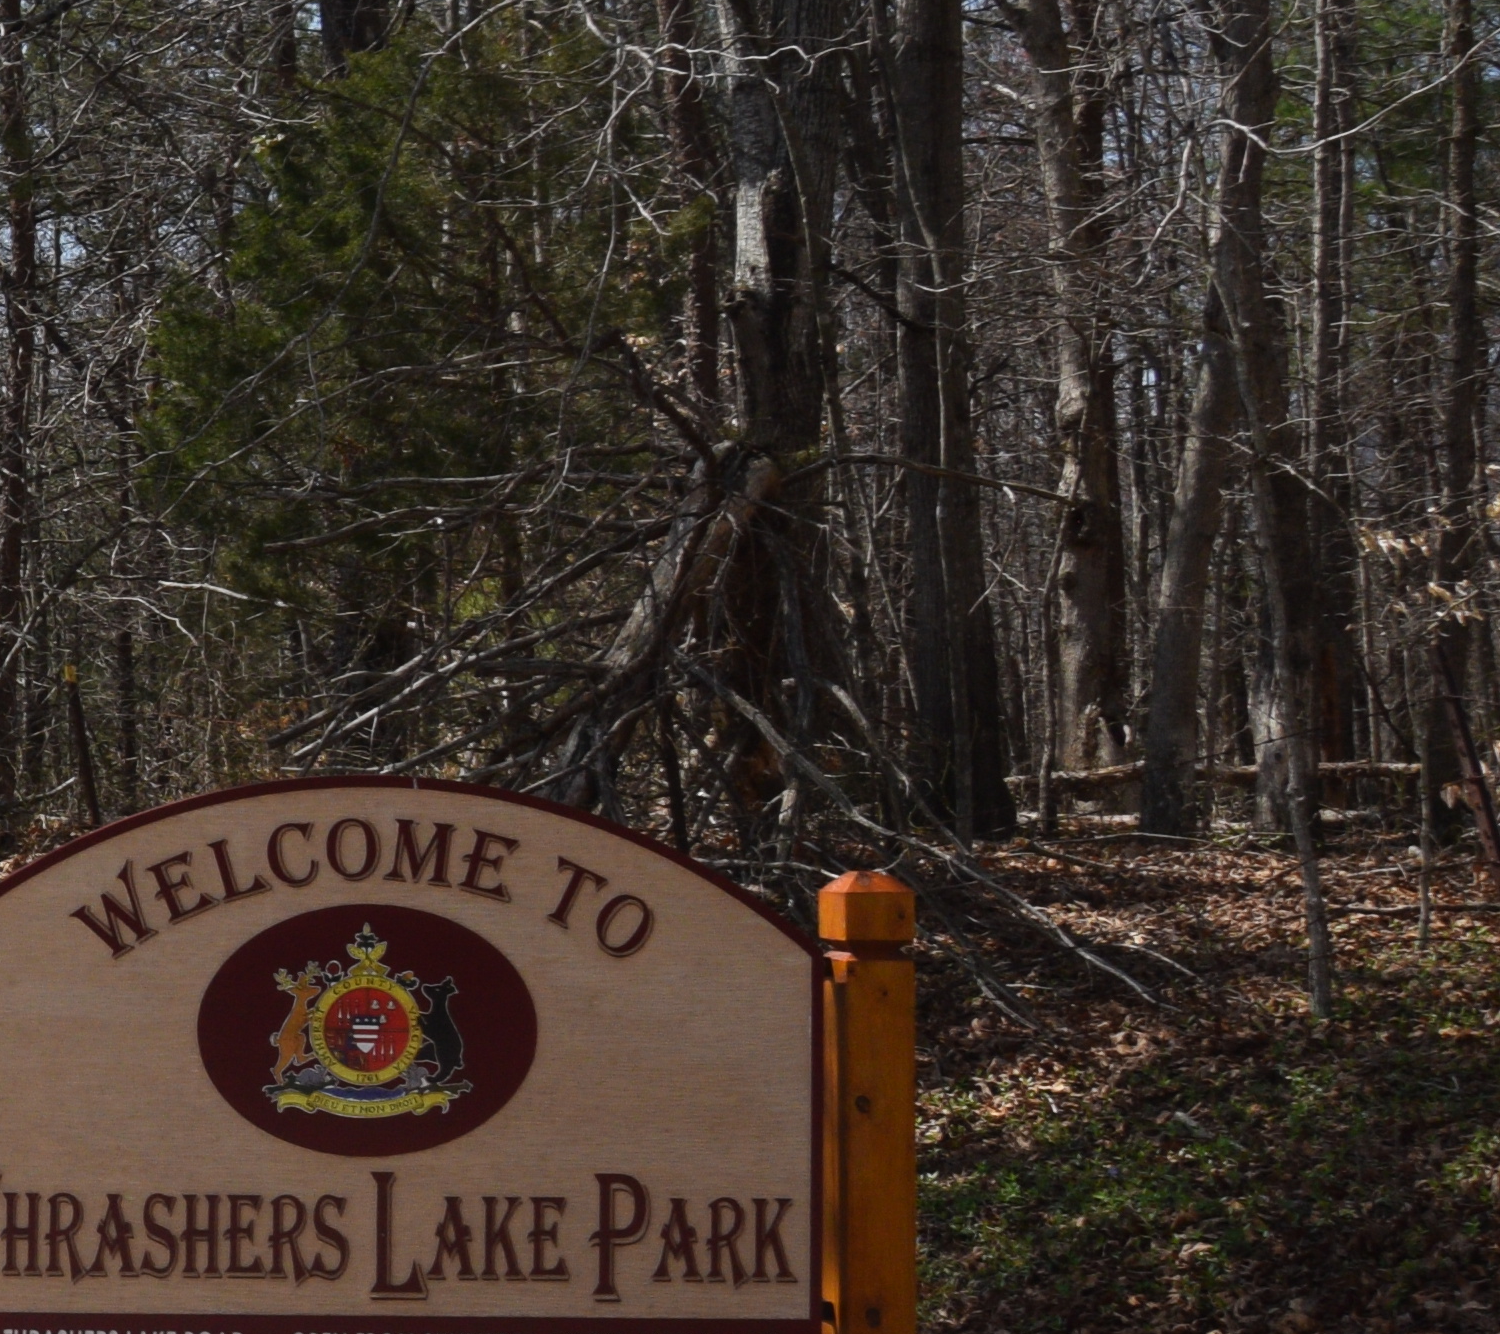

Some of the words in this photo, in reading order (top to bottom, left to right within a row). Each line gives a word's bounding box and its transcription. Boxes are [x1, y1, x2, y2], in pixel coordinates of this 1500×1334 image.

[69, 817, 520, 960] WELCOME
[547, 855, 654, 958] TO
[333, 976, 396, 996] COUNTY
[355, 1073, 380, 1083] 1761
[313, 1093, 340, 1110] DIEU
[341, 1103, 356, 1115] ET
[360, 1105, 386, 1116] MON
[388, 1096, 419, 1111] DROIT
[369, 1171, 570, 1301] LAKE
[589, 1173, 799, 1303] PARK
